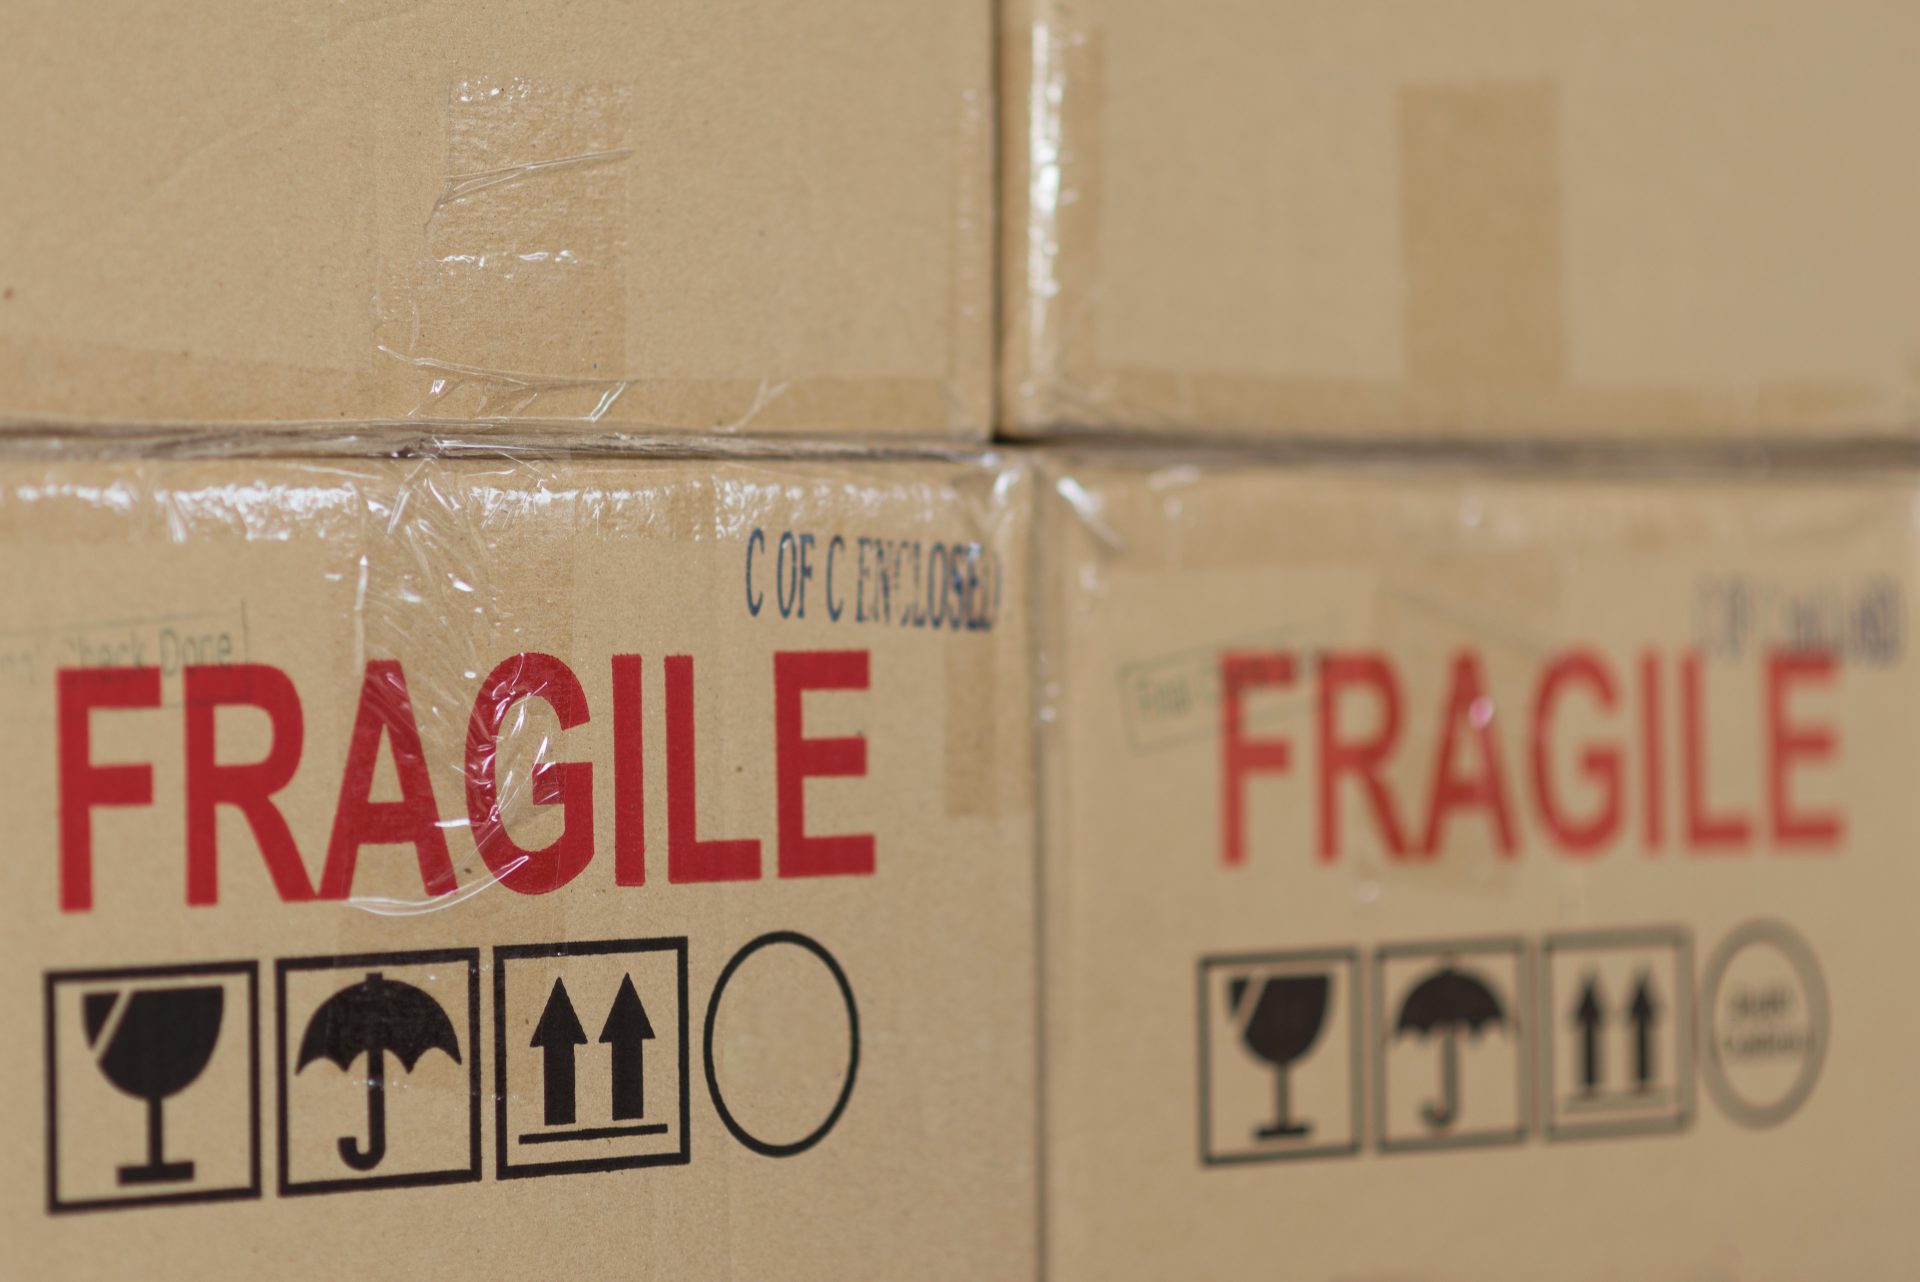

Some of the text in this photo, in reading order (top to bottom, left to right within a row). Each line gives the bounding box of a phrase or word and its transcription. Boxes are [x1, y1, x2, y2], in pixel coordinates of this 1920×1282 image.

[745, 527, 765, 617] C
[776, 530, 815, 619] OF
[826, 534, 845, 622] C
[56, 651, 876, 913] FRAGILE
[1220, 647, 1844, 868] FRAGILE
